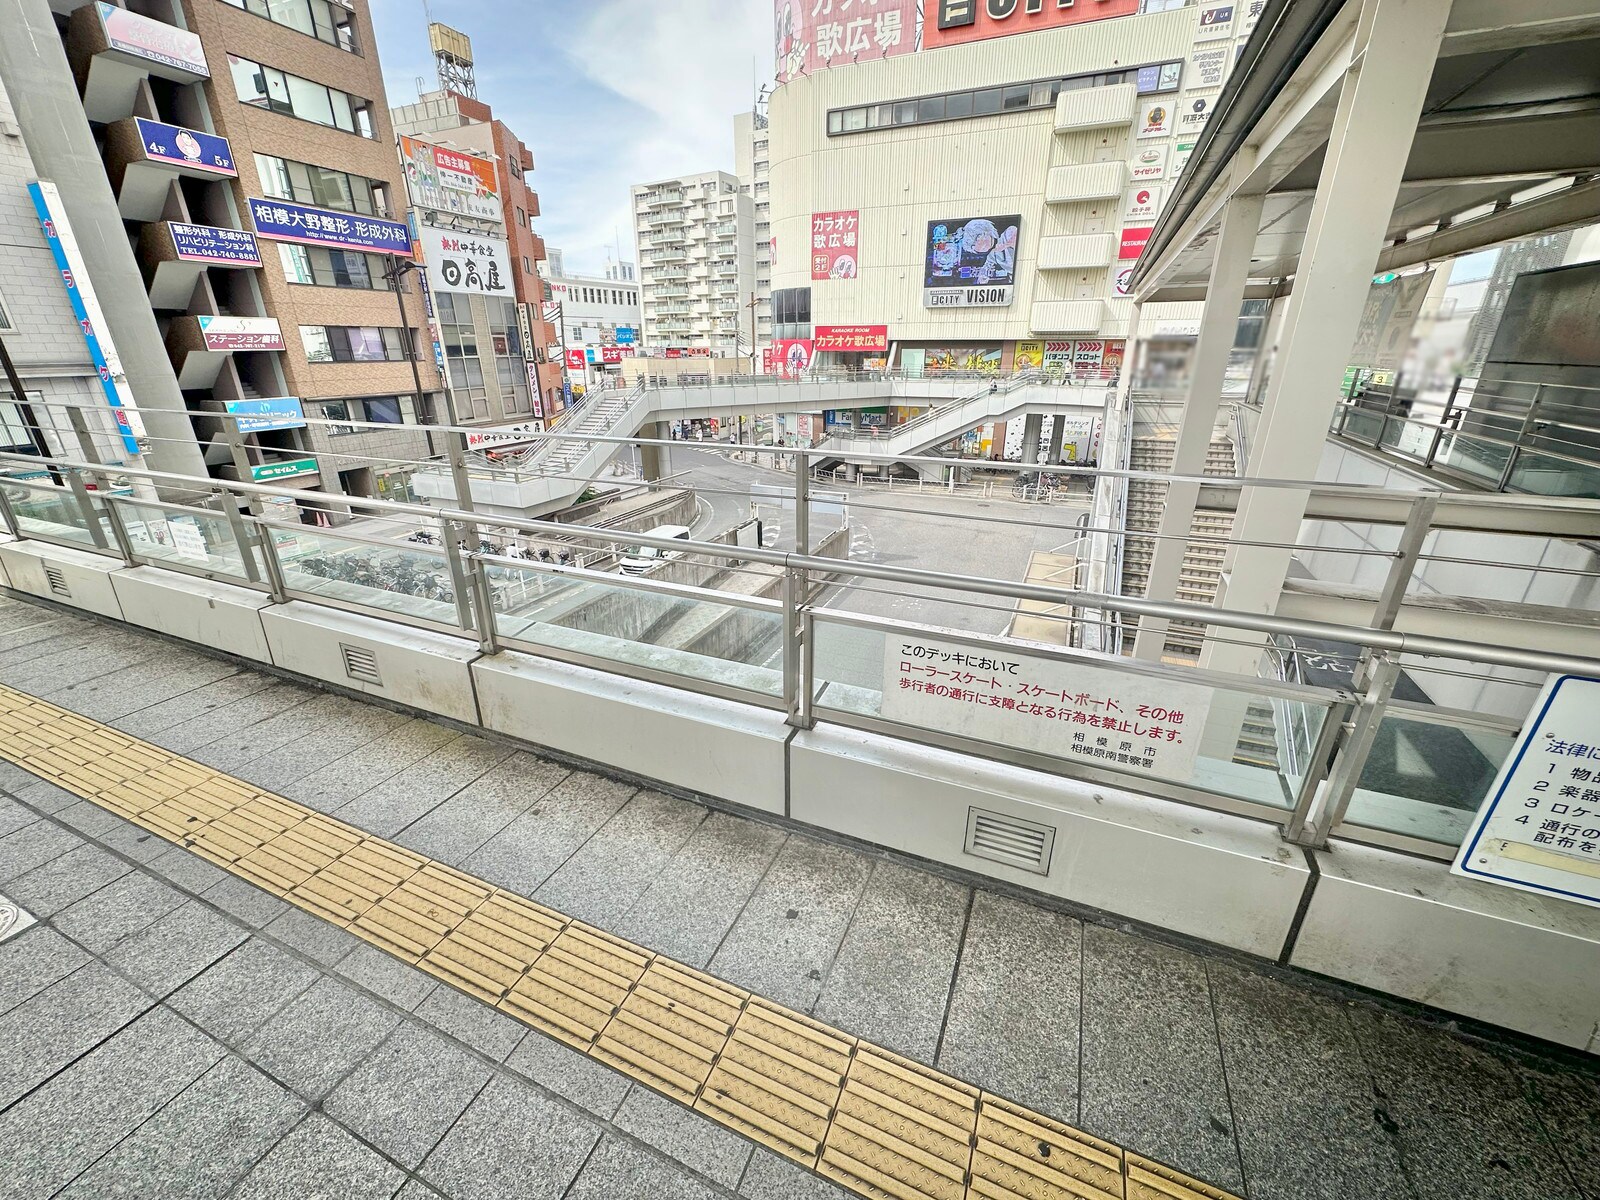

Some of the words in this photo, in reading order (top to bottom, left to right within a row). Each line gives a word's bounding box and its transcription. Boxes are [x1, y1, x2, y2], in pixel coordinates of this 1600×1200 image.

[816, 9, 903, 58] 歌広場
[149, 141, 167, 154] 4F
[213, 155, 230, 167] 5F
[436, 152, 472, 172] 広告主募集
[1134, 167, 1162, 176] サイゼリヤ
[254, 203, 408, 244] 相模大野整形・形成外科
[813, 215, 857, 232] カラオケ
[177, 235, 255, 253] リハビリテーション科
[441, 235, 495, 257] 熱烈中華食堂
[813, 231, 856, 249] 歌広場
[441, 257, 506, 291] 日高屋
[939, 295, 960, 304] CITY
[966, 288, 1005, 304] VISION
[208, 335, 280, 344] ステーション歯科
[816, 334, 885, 348] カラオケ歌広場
[603, 349, 635, 359] スギ薬局
[1376, 376, 1384, 384] 3
[841, 411, 882, 425] FayMart
[273, 465, 298, 474] セイムス
[900, 643, 1020, 676] このデッキにおいて
[899, 660, 1184, 725] ローラースケート・スケートボード、その他
[899, 677, 1183, 745] 歩行者の通行に支障となる行為を禁止します。
[1072, 731, 1157, 757] 相模原市
[1070, 743, 1154, 769] 相模原南警察署
[1547, 763, 1557, 774] 1
[1533, 780, 1549, 792] 2
[1524, 797, 1540, 808] 3
[1550, 802, 1600, 818] ロケ
[1515, 815, 1529, 825] 4
[1539, 818, 1600, 840] 通行の
[1533, 831, 1600, 856] 配布を
